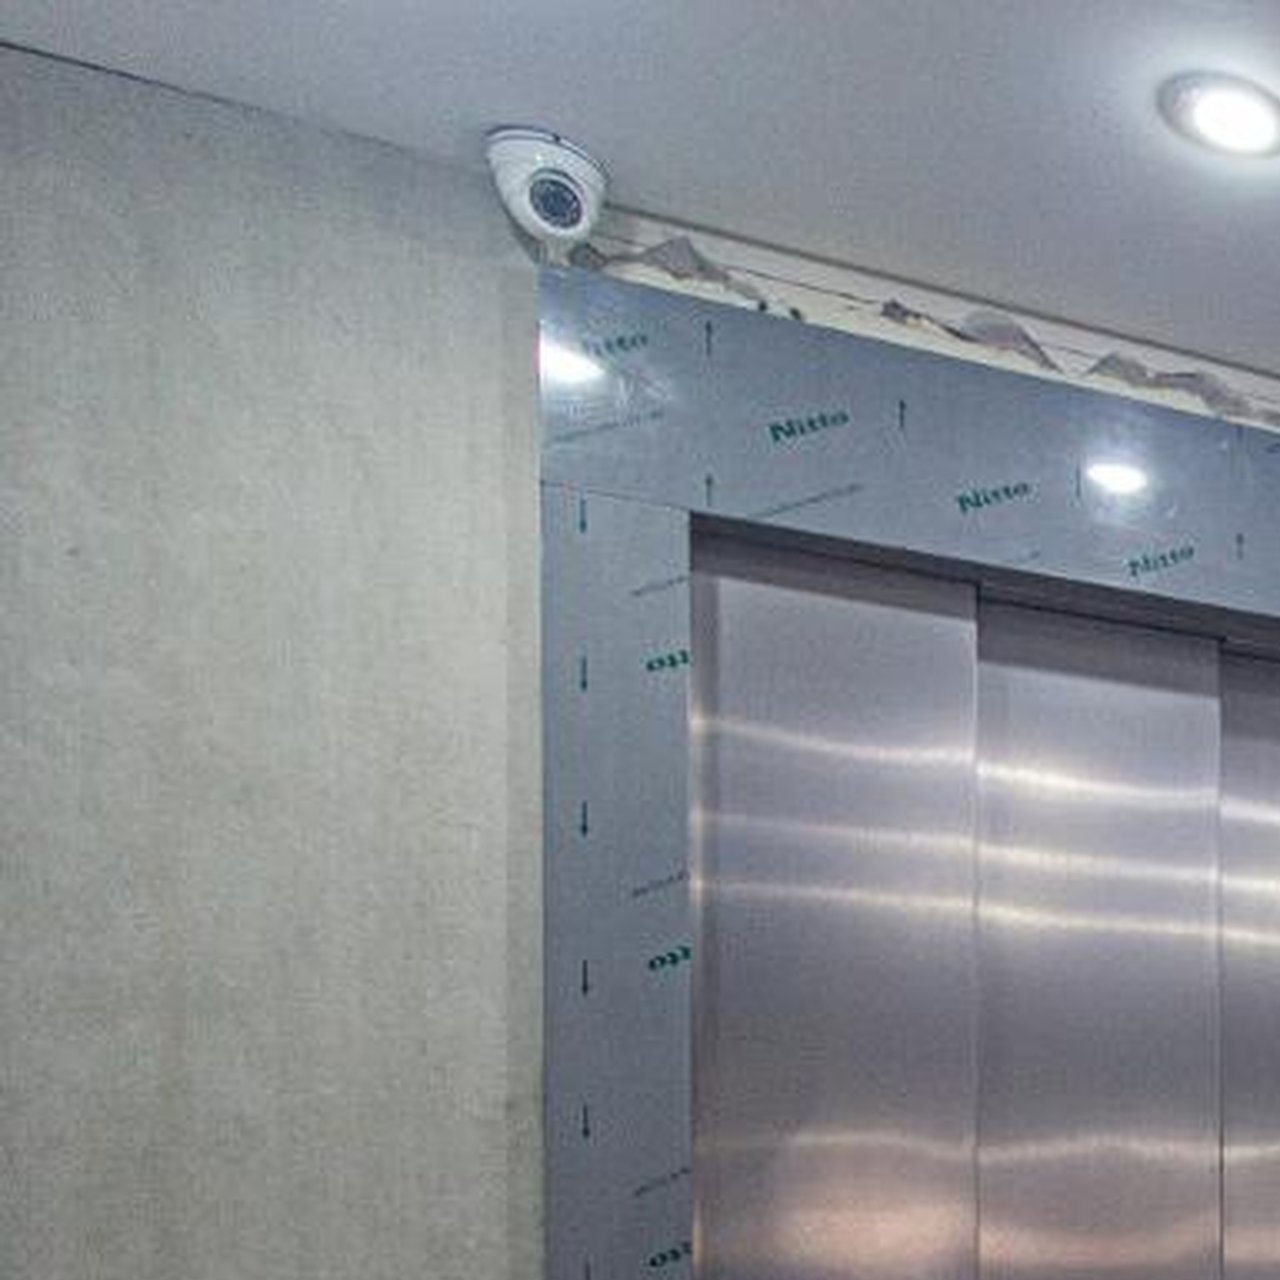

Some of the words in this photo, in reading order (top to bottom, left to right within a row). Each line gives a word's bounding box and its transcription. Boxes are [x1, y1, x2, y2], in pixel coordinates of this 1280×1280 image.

[769, 410, 850, 443] Nitto
[957, 480, 1031, 514] Nitto
[1128, 544, 1195, 577] Nitto
[646, 650, 690, 672] tto
[648, 946, 691, 971] tto
